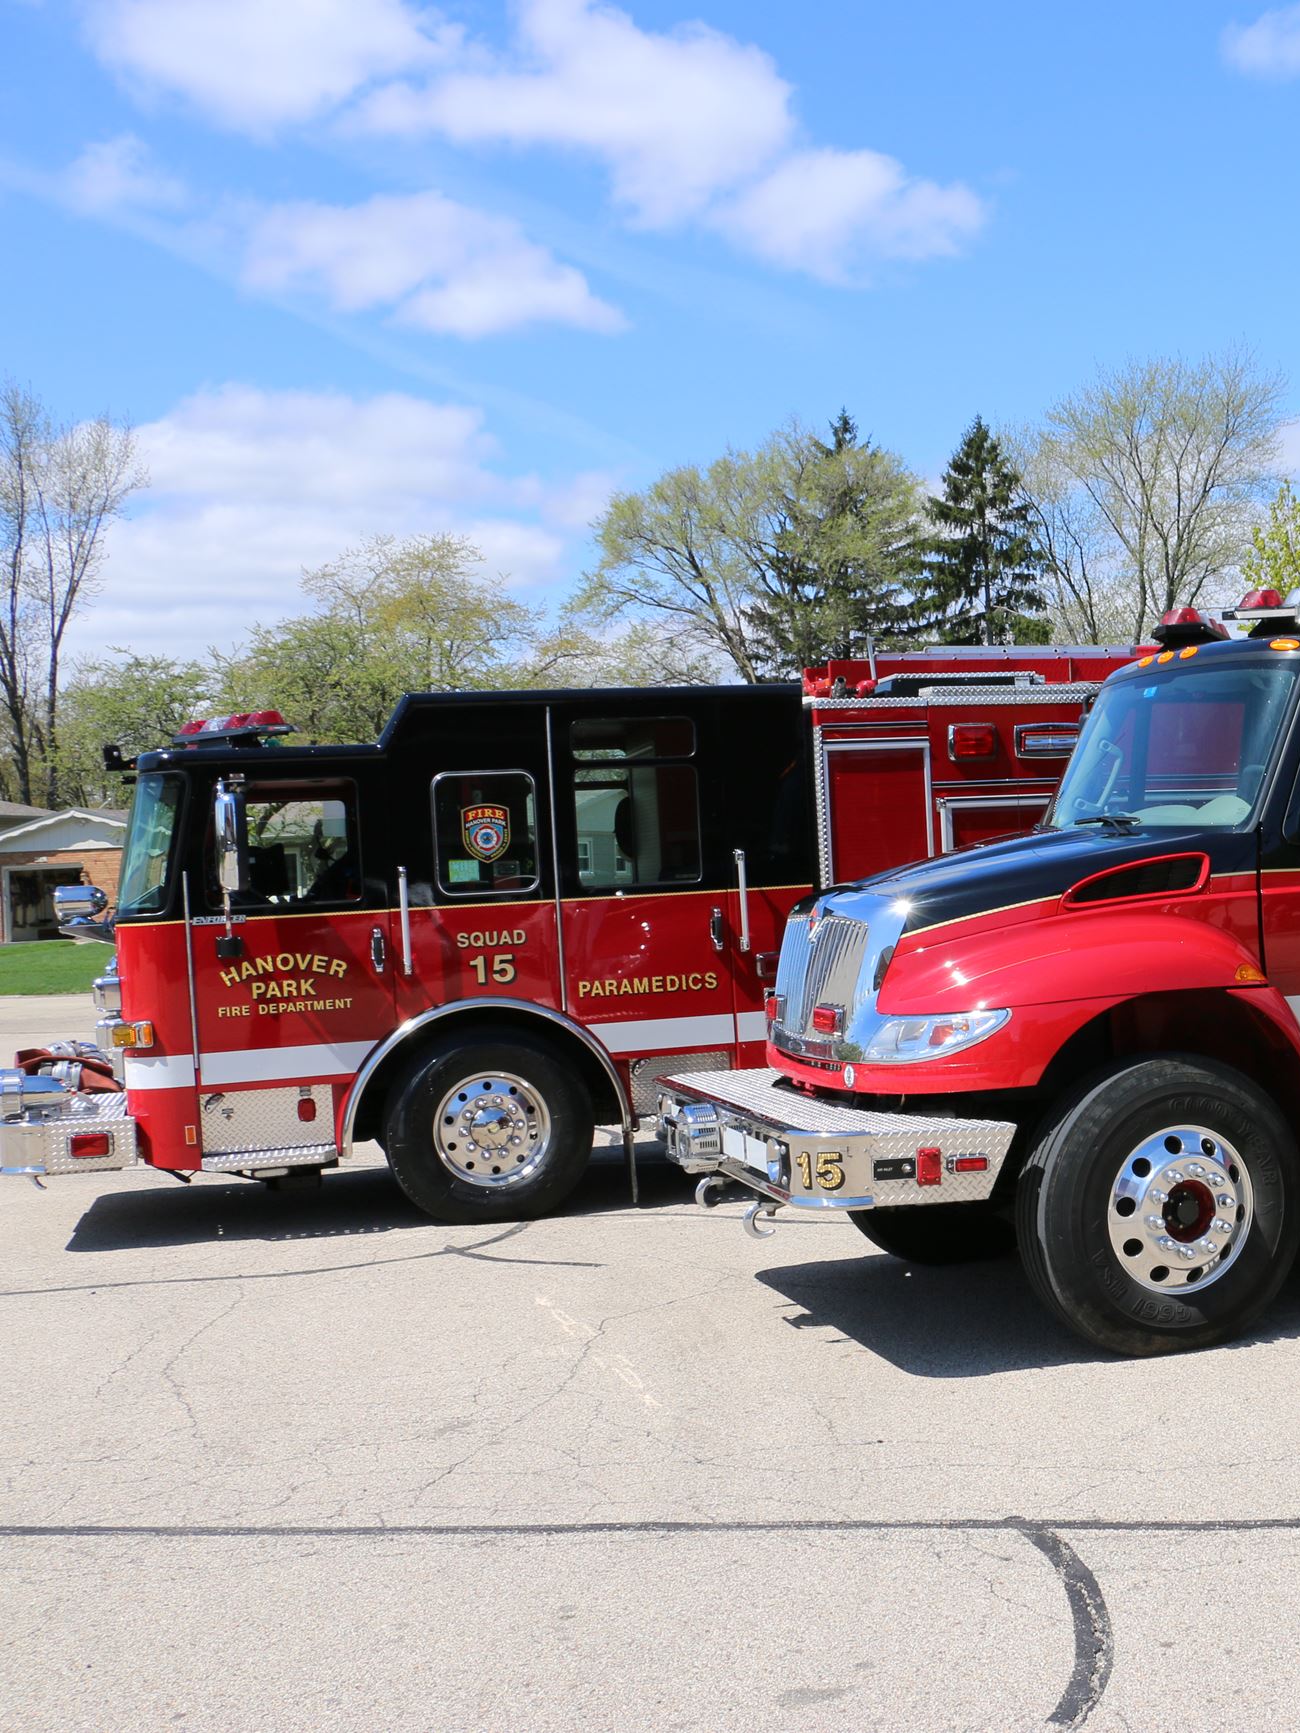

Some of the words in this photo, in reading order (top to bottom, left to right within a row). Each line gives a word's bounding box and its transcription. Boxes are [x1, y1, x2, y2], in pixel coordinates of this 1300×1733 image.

[468, 808, 504, 821] FIRE
[192, 914, 247, 926] ENFORER
[456, 929, 528, 949] SQUAD
[219, 953, 349, 988] HANOVER
[469, 953, 516, 984] 15
[251, 978, 317, 1000] PARK
[578, 972, 719, 998] PARAMEDICS
[218, 1005, 251, 1018] FIRE
[258, 998, 352, 1015] DEPARTMENT
[796, 1151, 846, 1190] 15
